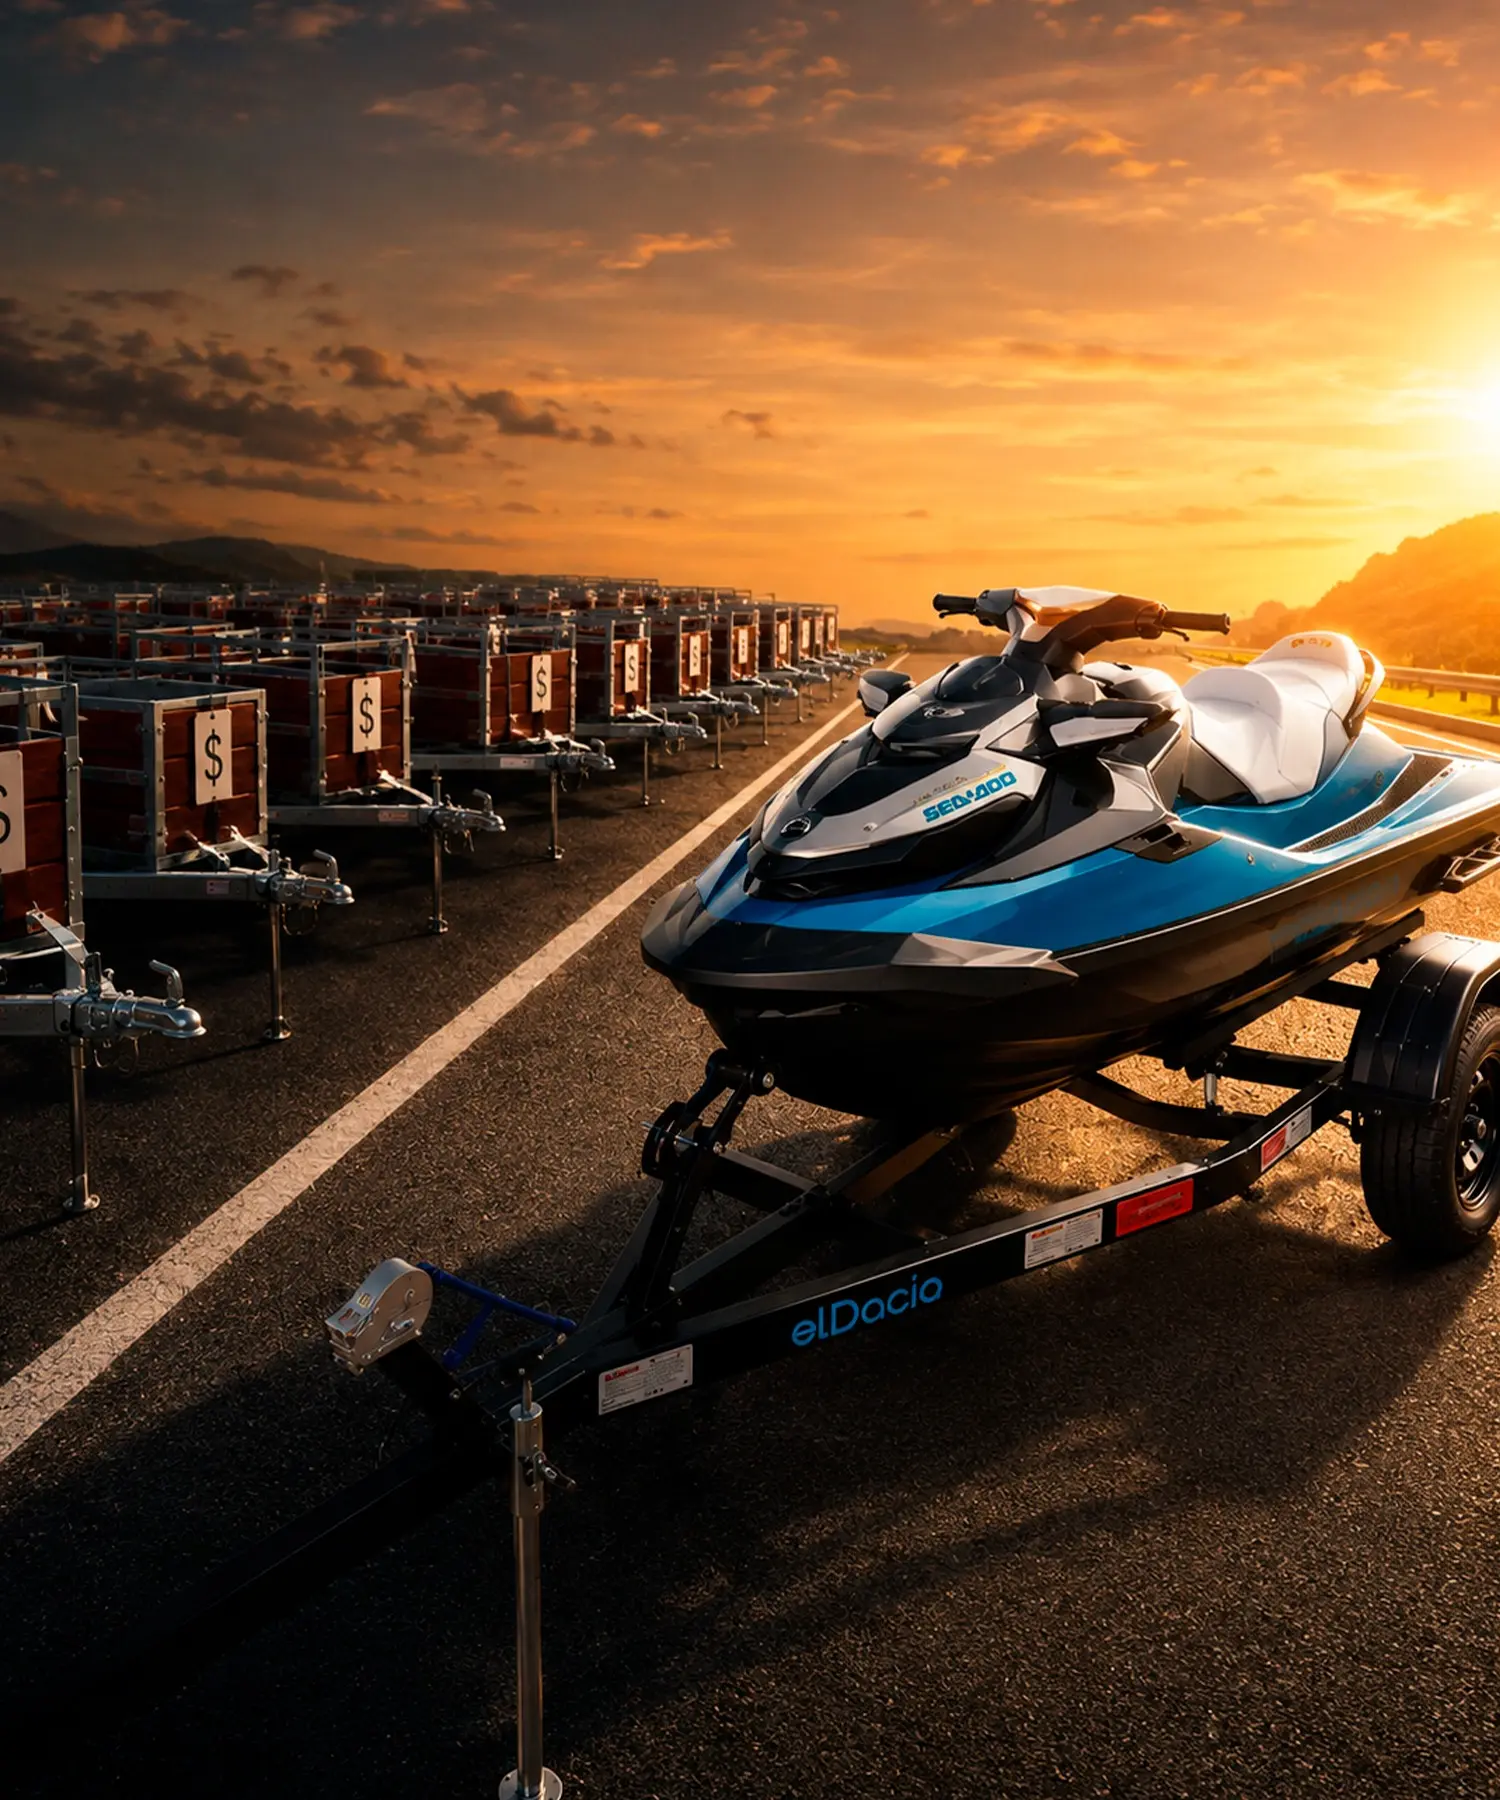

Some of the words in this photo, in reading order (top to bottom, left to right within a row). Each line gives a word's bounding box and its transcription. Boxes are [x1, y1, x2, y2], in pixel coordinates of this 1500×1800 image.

[536, 665, 548, 703] $
[359, 692, 374, 739] $
[205, 728, 223, 787] $
